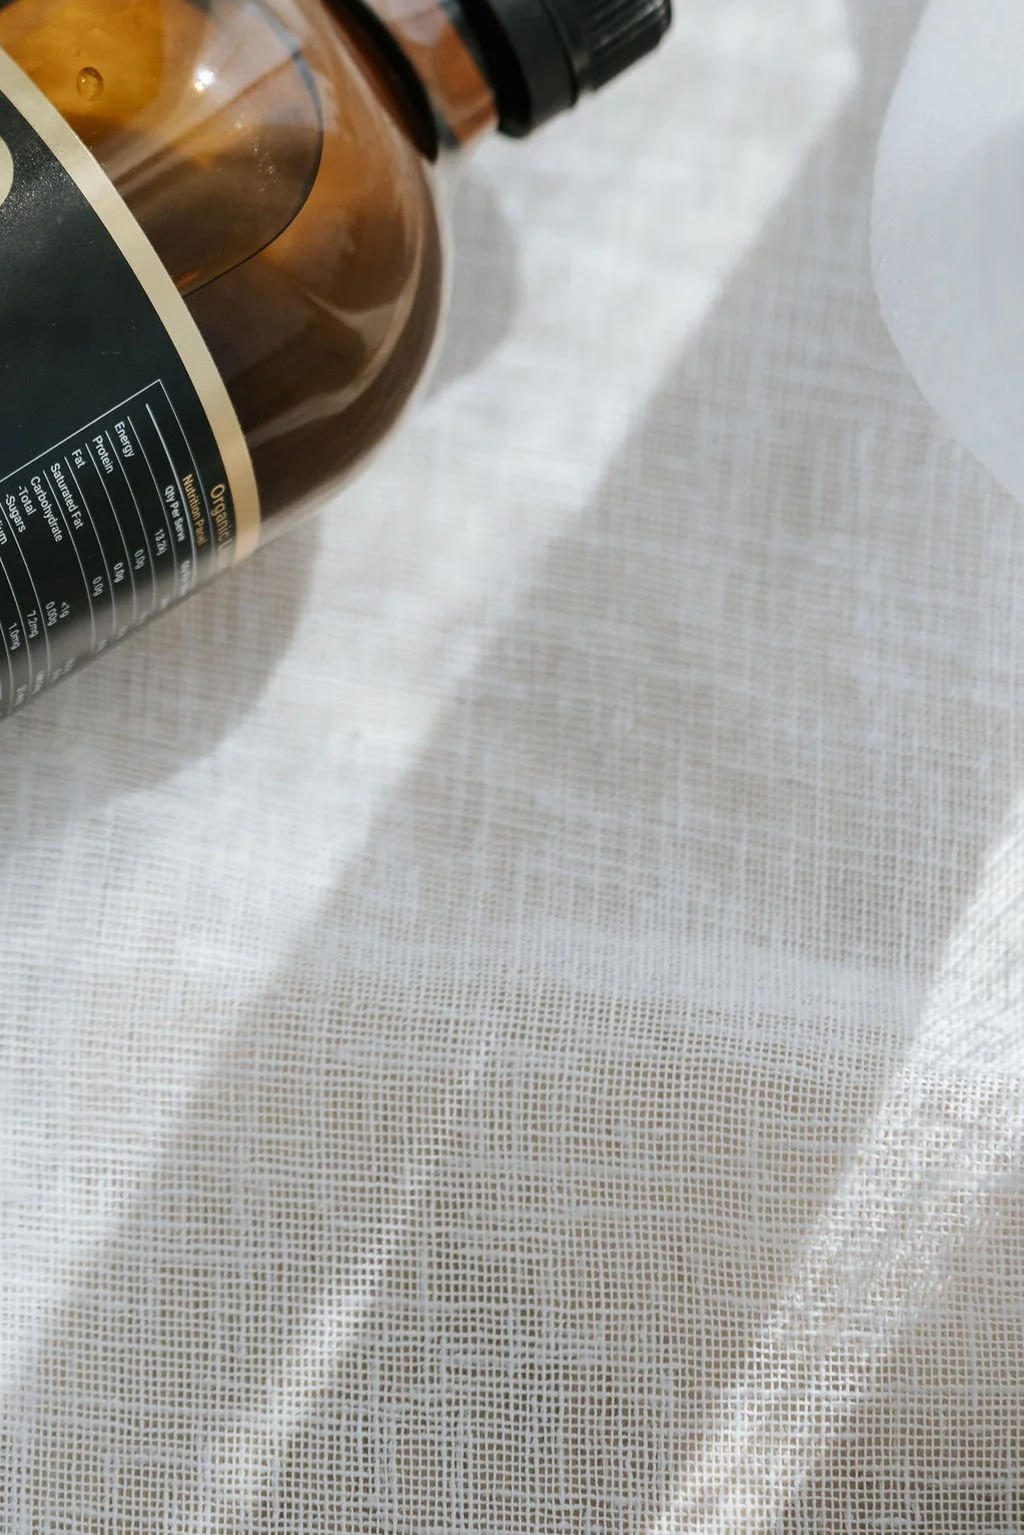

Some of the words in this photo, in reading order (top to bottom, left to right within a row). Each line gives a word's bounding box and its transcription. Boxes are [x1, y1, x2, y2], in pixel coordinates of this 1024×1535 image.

[71, 448, 86, 469] Fat
[92, 435, 114, 474] Protein
[114, 421, 135, 458] Energy
[6, 494, 26, 533] -Sugars
[18, 486, 36, 516] -Total
[30, 476, 62, 543] Carbohydrate
[50, 462, 76, 512] Saturated
[71, 511, 84, 530] Fat
[164, 485, 176, 504] Qty
[171, 502, 181, 519] Per
[182, 473, 201, 522] Nutrition
[211, 484, 233, 541] Organic
[175, 516, 186, 542] Serve
